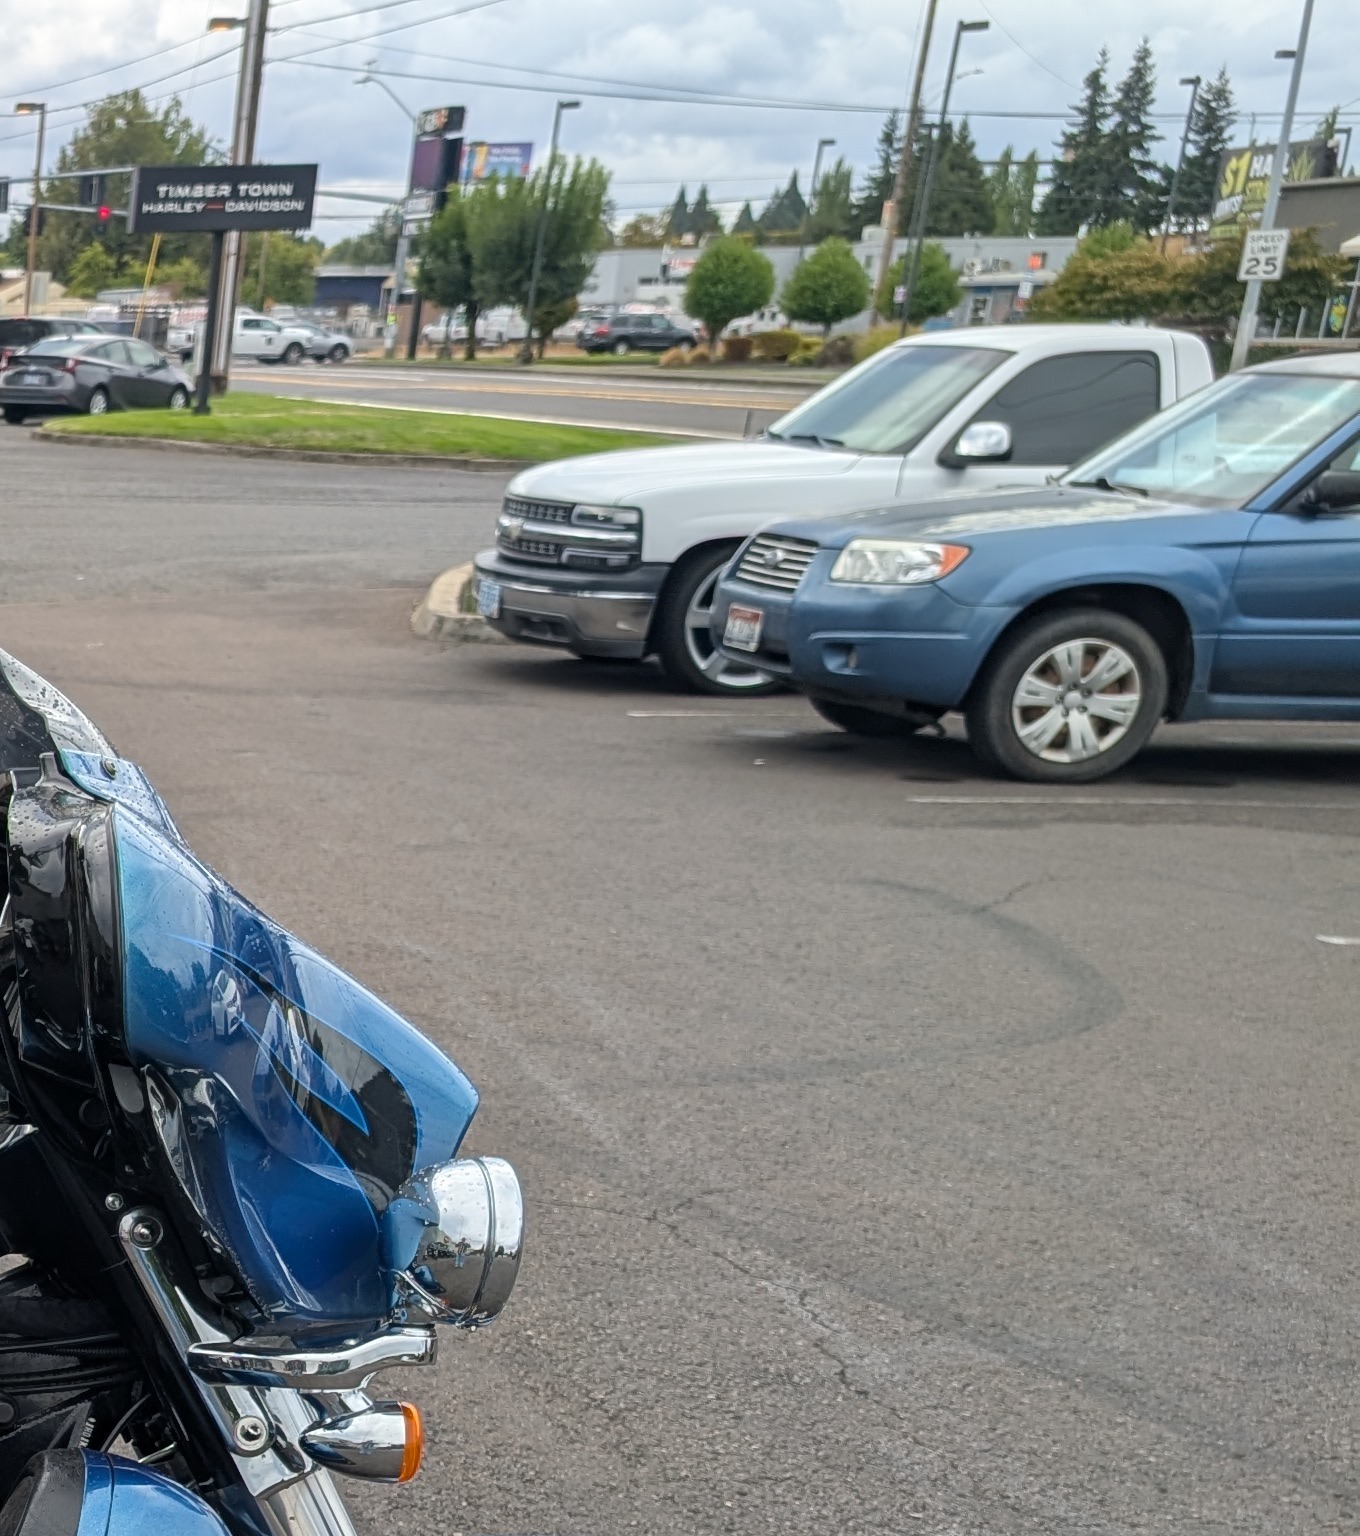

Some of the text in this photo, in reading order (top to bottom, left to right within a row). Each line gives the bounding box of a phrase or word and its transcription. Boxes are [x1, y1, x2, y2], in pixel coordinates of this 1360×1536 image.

[157, 180, 294, 198] TIMBER TOWN
[1249, 233, 1285, 243] SPEED
[1250, 244, 1279, 255] LIMIT
[1245, 257, 1278, 276] 25
